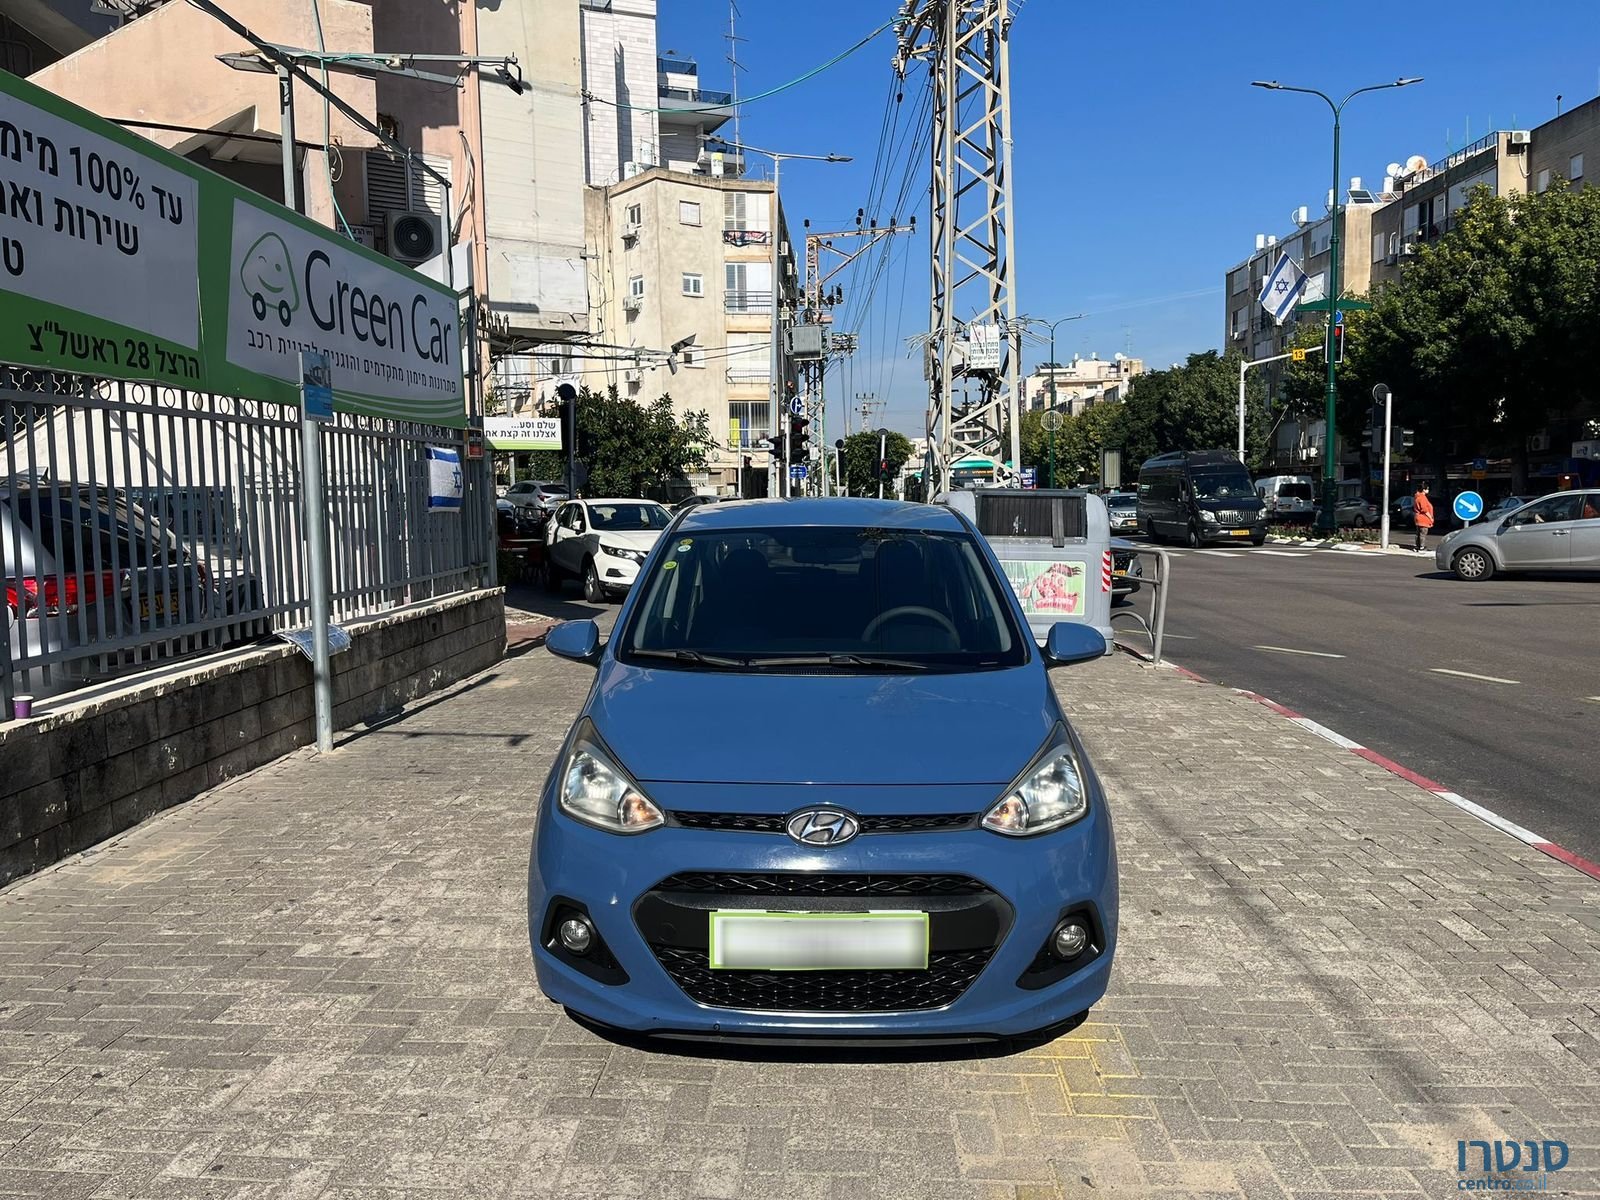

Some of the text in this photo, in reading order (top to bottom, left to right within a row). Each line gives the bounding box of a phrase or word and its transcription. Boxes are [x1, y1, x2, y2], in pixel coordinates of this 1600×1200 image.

[69, 146, 145, 211] 100%
[152, 185, 183, 225] עד
[54, 197, 139, 256] שירות
[305, 249, 451, 365] Green Car
[248, 329, 272, 352] רכב
[125, 338, 150, 370] 28
[155, 343, 200, 379] הרצל
[1295, 350, 1304, 358] 13
[364, 359, 404, 382] מתקדמים
[406, 369, 427, 386] מימון
[429, 376, 456, 393] פתרונות
[500, 430, 518, 439] קצת
[521, 430, 531, 438] זה
[533, 430, 556, 438] אצלנו
[537, 420, 556, 429] שלם
